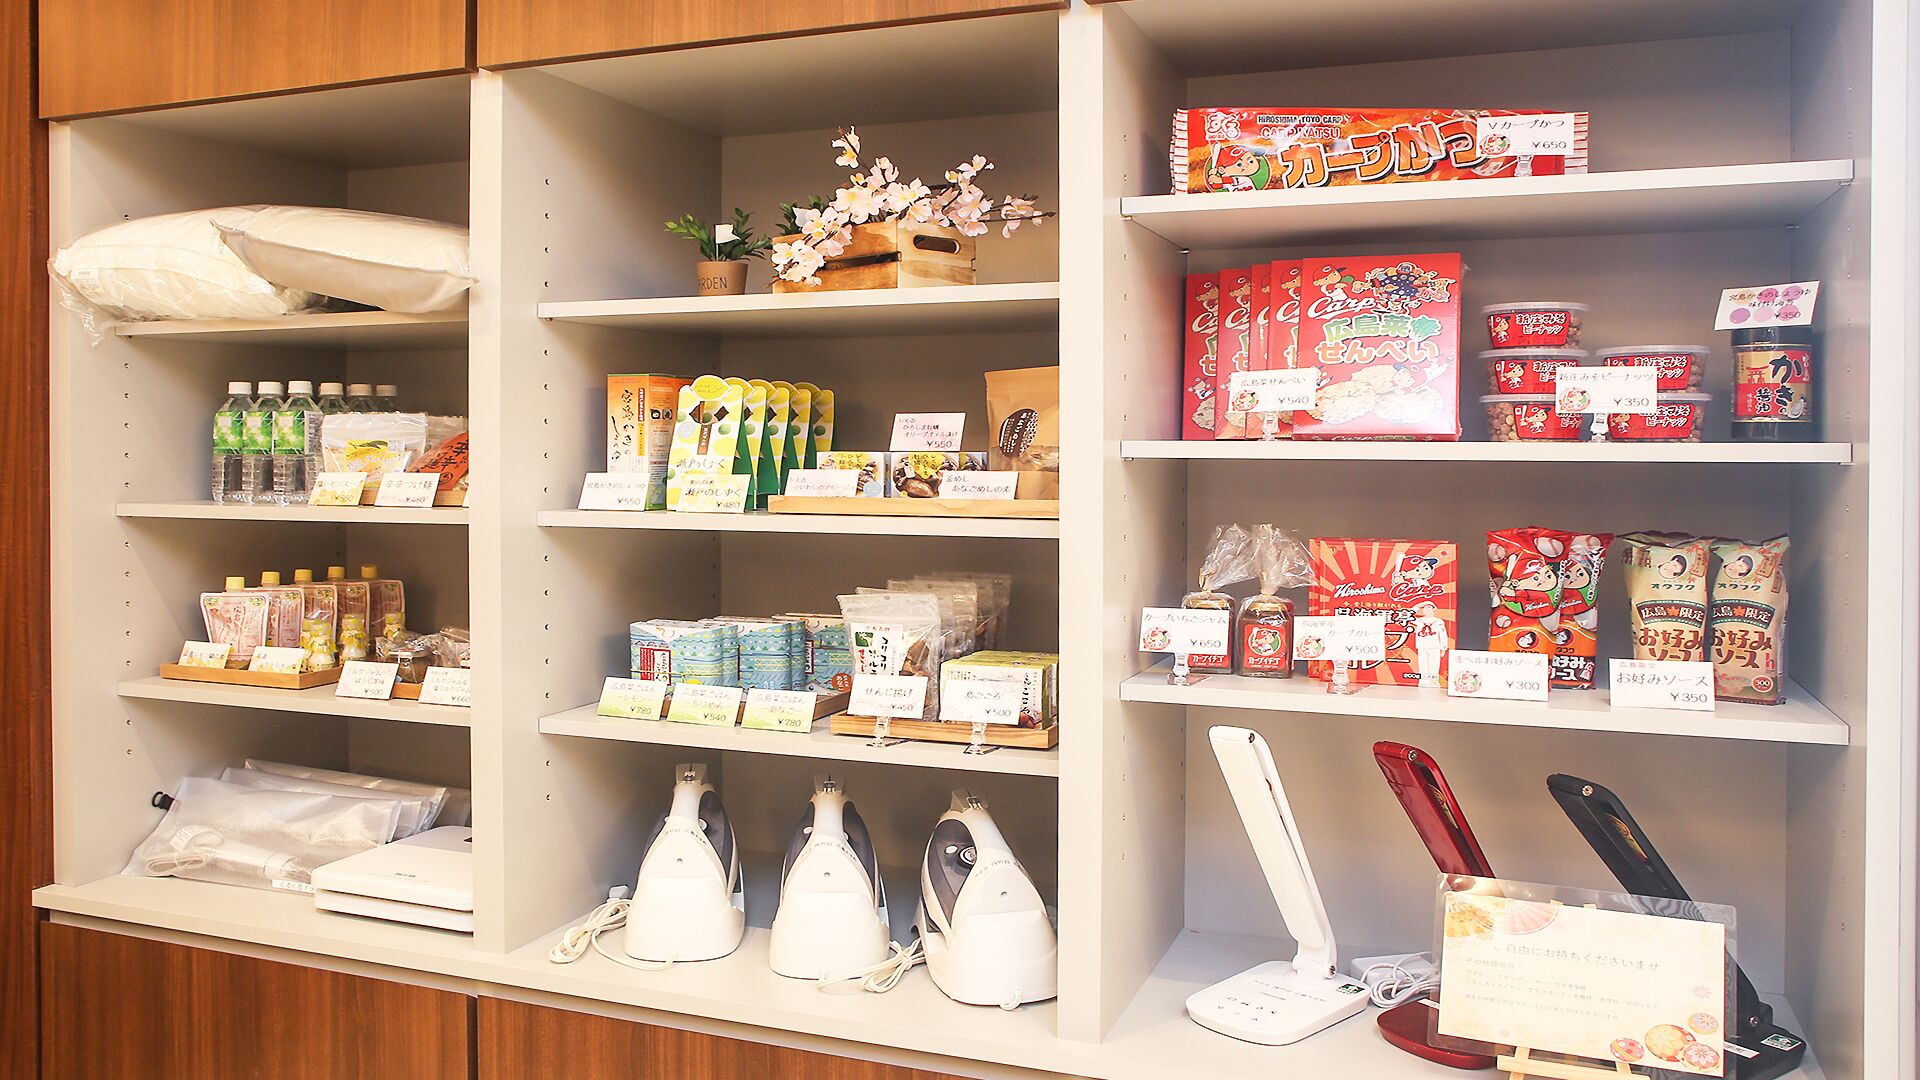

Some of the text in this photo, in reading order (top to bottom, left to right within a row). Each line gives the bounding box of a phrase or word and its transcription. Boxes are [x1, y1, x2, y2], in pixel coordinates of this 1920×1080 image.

[1300, 115, 1320, 124] TOYO
[1323, 114, 1342, 124] CARP
[1302, 127, 1341, 139] KATSU
[1532, 141, 1567, 149] ¥650
[1281, 119, 1488, 191] カープかつ
[1315, 340, 1440, 364] せんべい
[1278, 396, 1309, 405] ¥540
[1613, 397, 1650, 407] ¥350
[926, 440, 953, 448] ¥550
[1190, 638, 1222, 648] ¥650
[1345, 645, 1378, 654] ¥500
[1716, 649, 1760, 669] ソース
[1616, 672, 1709, 687] お好みソース
[1751, 679, 1770, 687] 300
[1505, 680, 1540, 691] ¥300
[1670, 692, 1708, 703] ¥350
[703, 712, 727, 721] ¥540
[984, 708, 1012, 717] ¥500
[777, 717, 802, 727] ¥780
